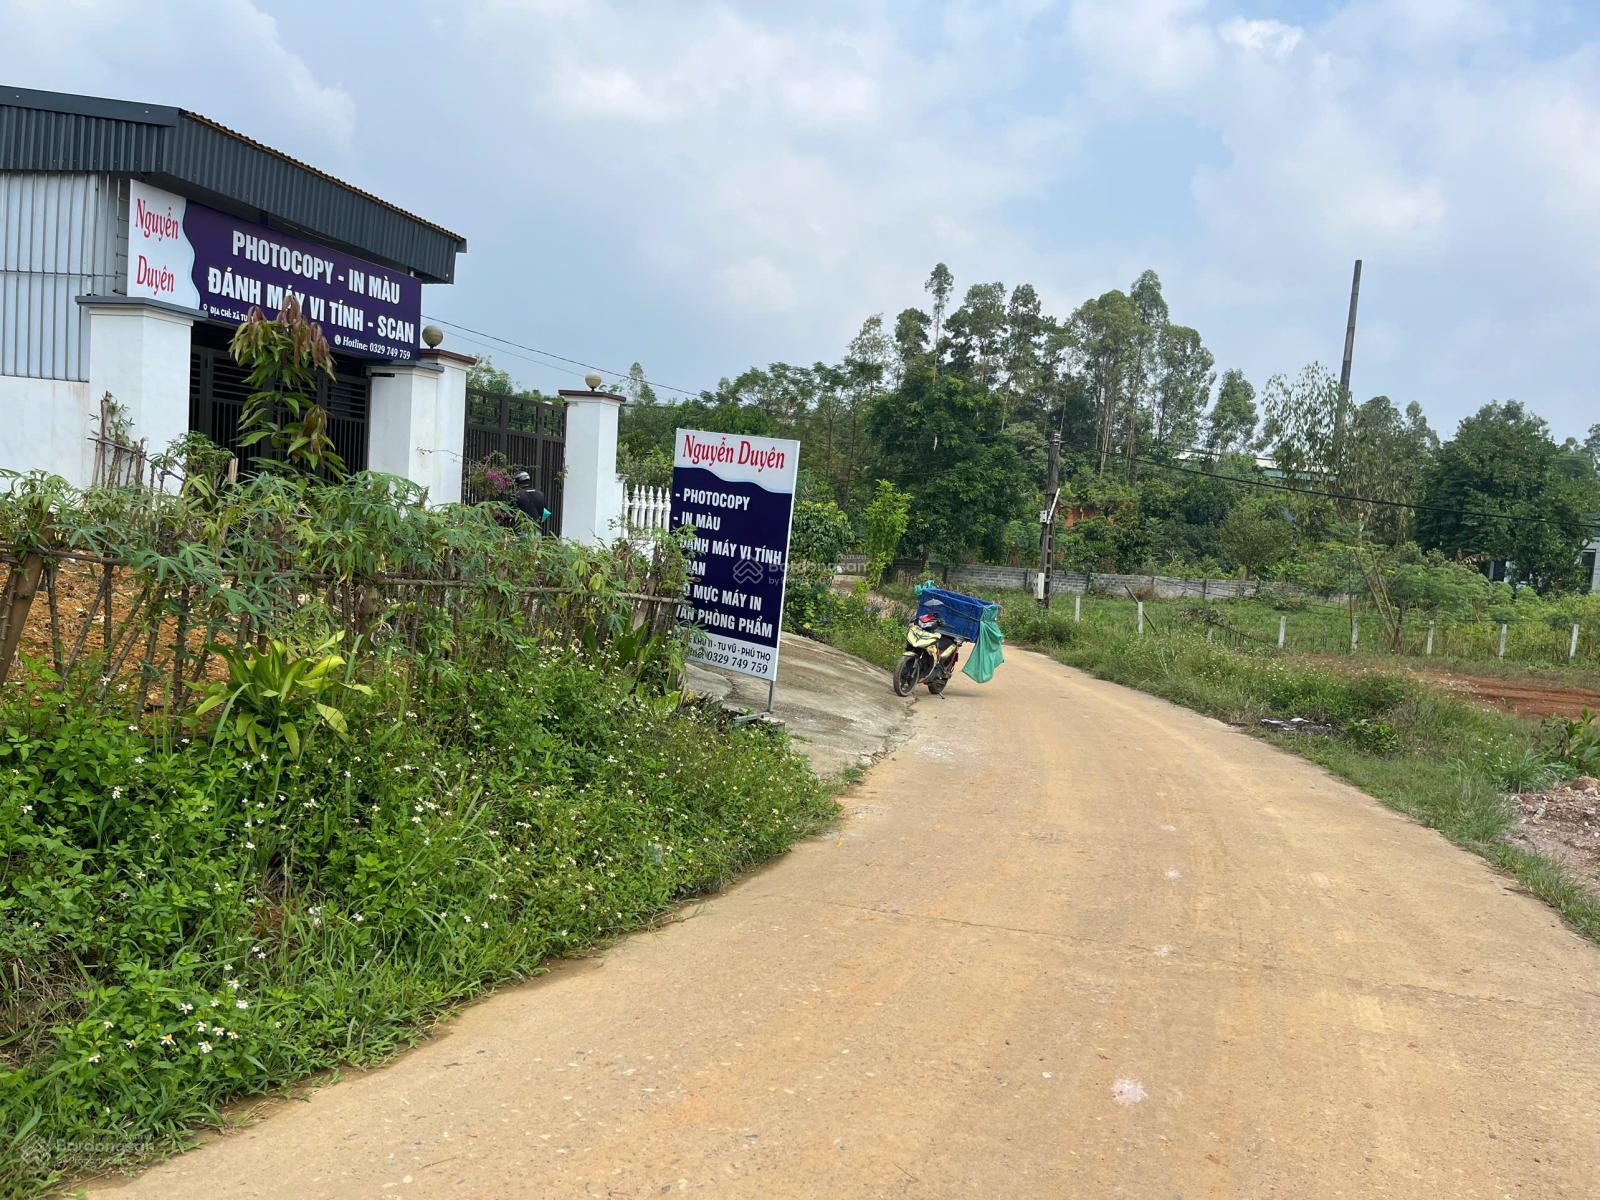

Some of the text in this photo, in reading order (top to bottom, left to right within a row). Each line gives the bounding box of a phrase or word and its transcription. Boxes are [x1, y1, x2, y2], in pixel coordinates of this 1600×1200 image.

[136, 198, 179, 242] Nguyễn
[136, 255, 175, 295] Duyên
[232, 230, 334, 285] PHOTOCOPY
[348, 269, 365, 294] IN
[368, 275, 400, 304] MÀU
[207, 267, 262, 305] ĐÁNH
[309, 295, 325, 322] VI
[329, 300, 364, 332] TÍNH
[377, 315, 414, 344] SCAN
[342, 336, 411, 360] Hotline: 0329 749 759
[683, 434, 785, 472] Nguyễn Duyên
[683, 488, 750, 511] PHOTOCOPY
[681, 512, 693, 525] IN
[696, 512, 721, 531] MÀU
[712, 539, 737, 558] MÁY
[755, 545, 782, 565] TÍNH
[693, 585, 719, 603] MỰC
[721, 589, 747, 608] MÁY
[749, 596, 762, 611] IN
[697, 609, 735, 630] PHÒNG
[738, 616, 773, 638] PHẨM
[708, 650, 729, 665] 0329
[732, 657, 748, 669] 749
[752, 661, 768, 674] 759
[757, 650, 771, 664] THỌ
